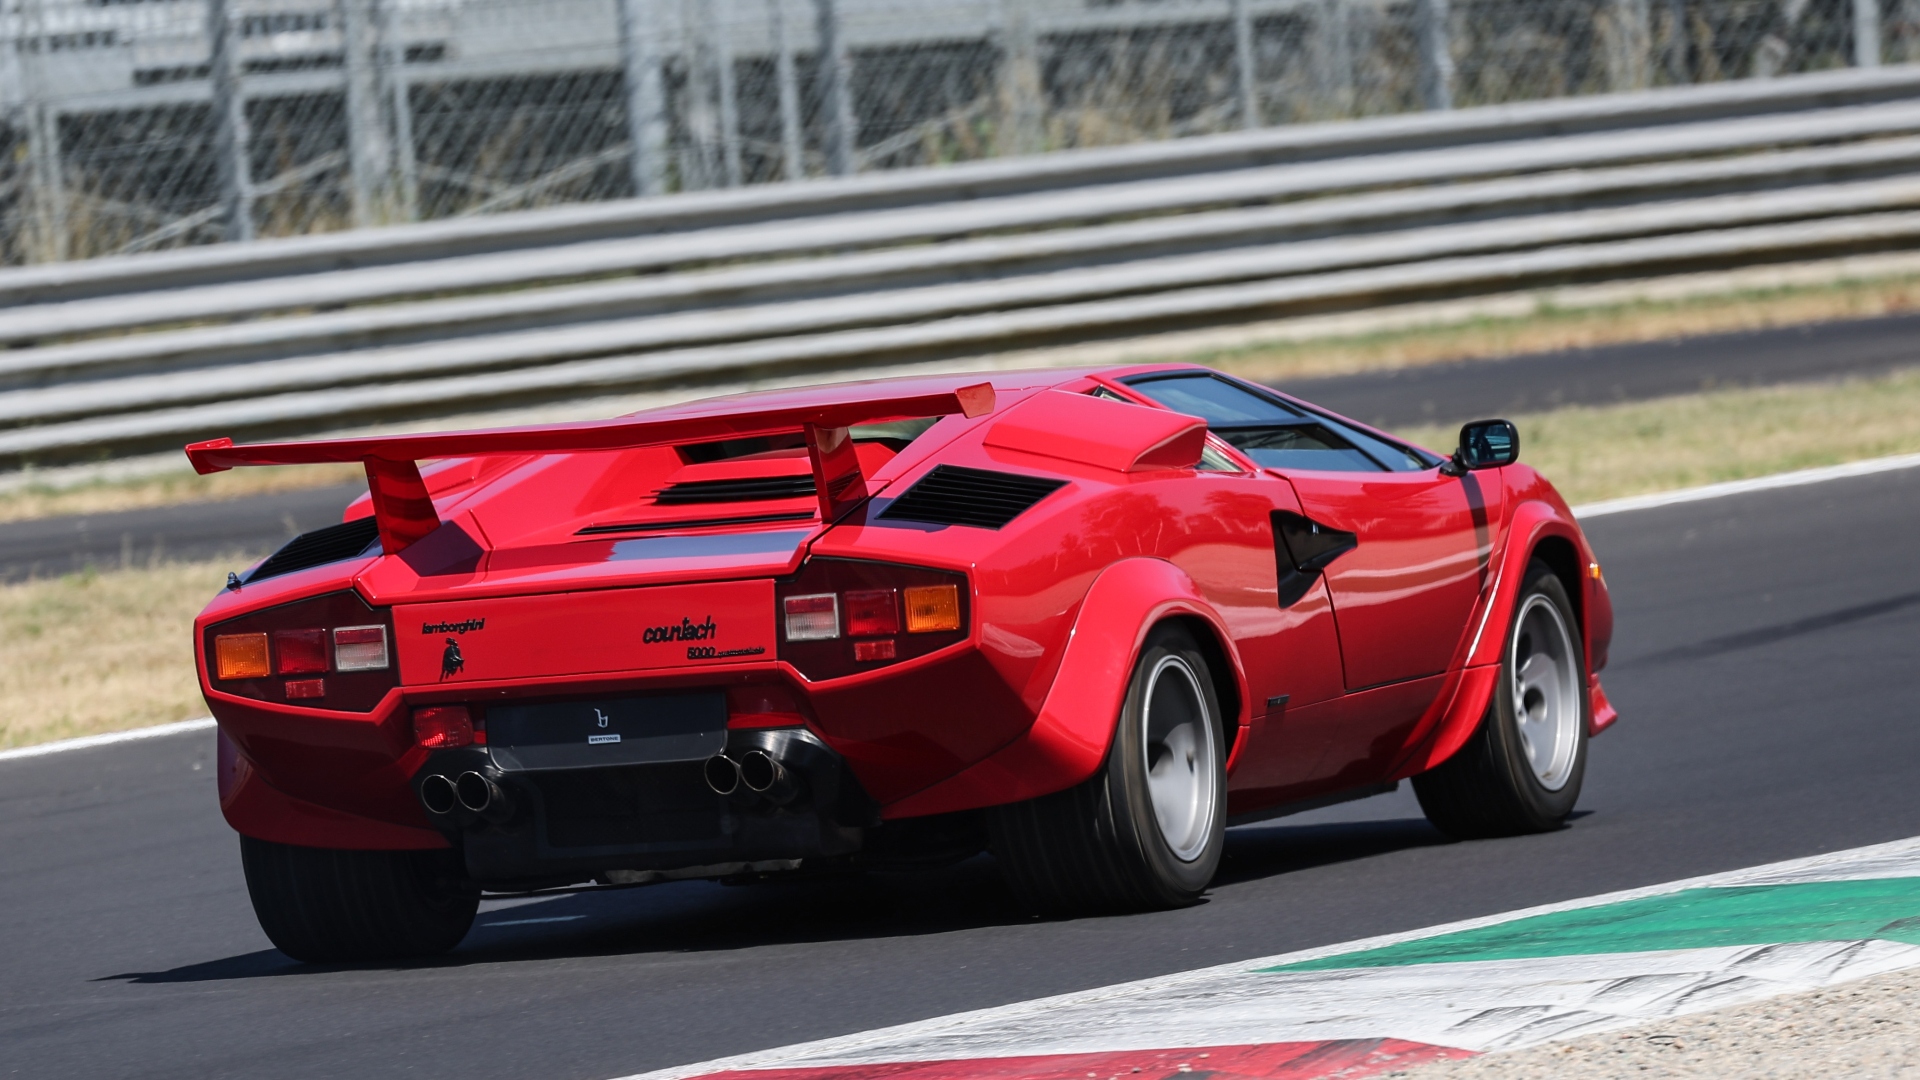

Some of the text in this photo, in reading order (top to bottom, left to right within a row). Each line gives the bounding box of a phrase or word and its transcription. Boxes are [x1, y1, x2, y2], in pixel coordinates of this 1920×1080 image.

[422, 617, 485, 634] lamborghini
[643, 615, 716, 643] countach
[687, 646, 716, 659] 5000
